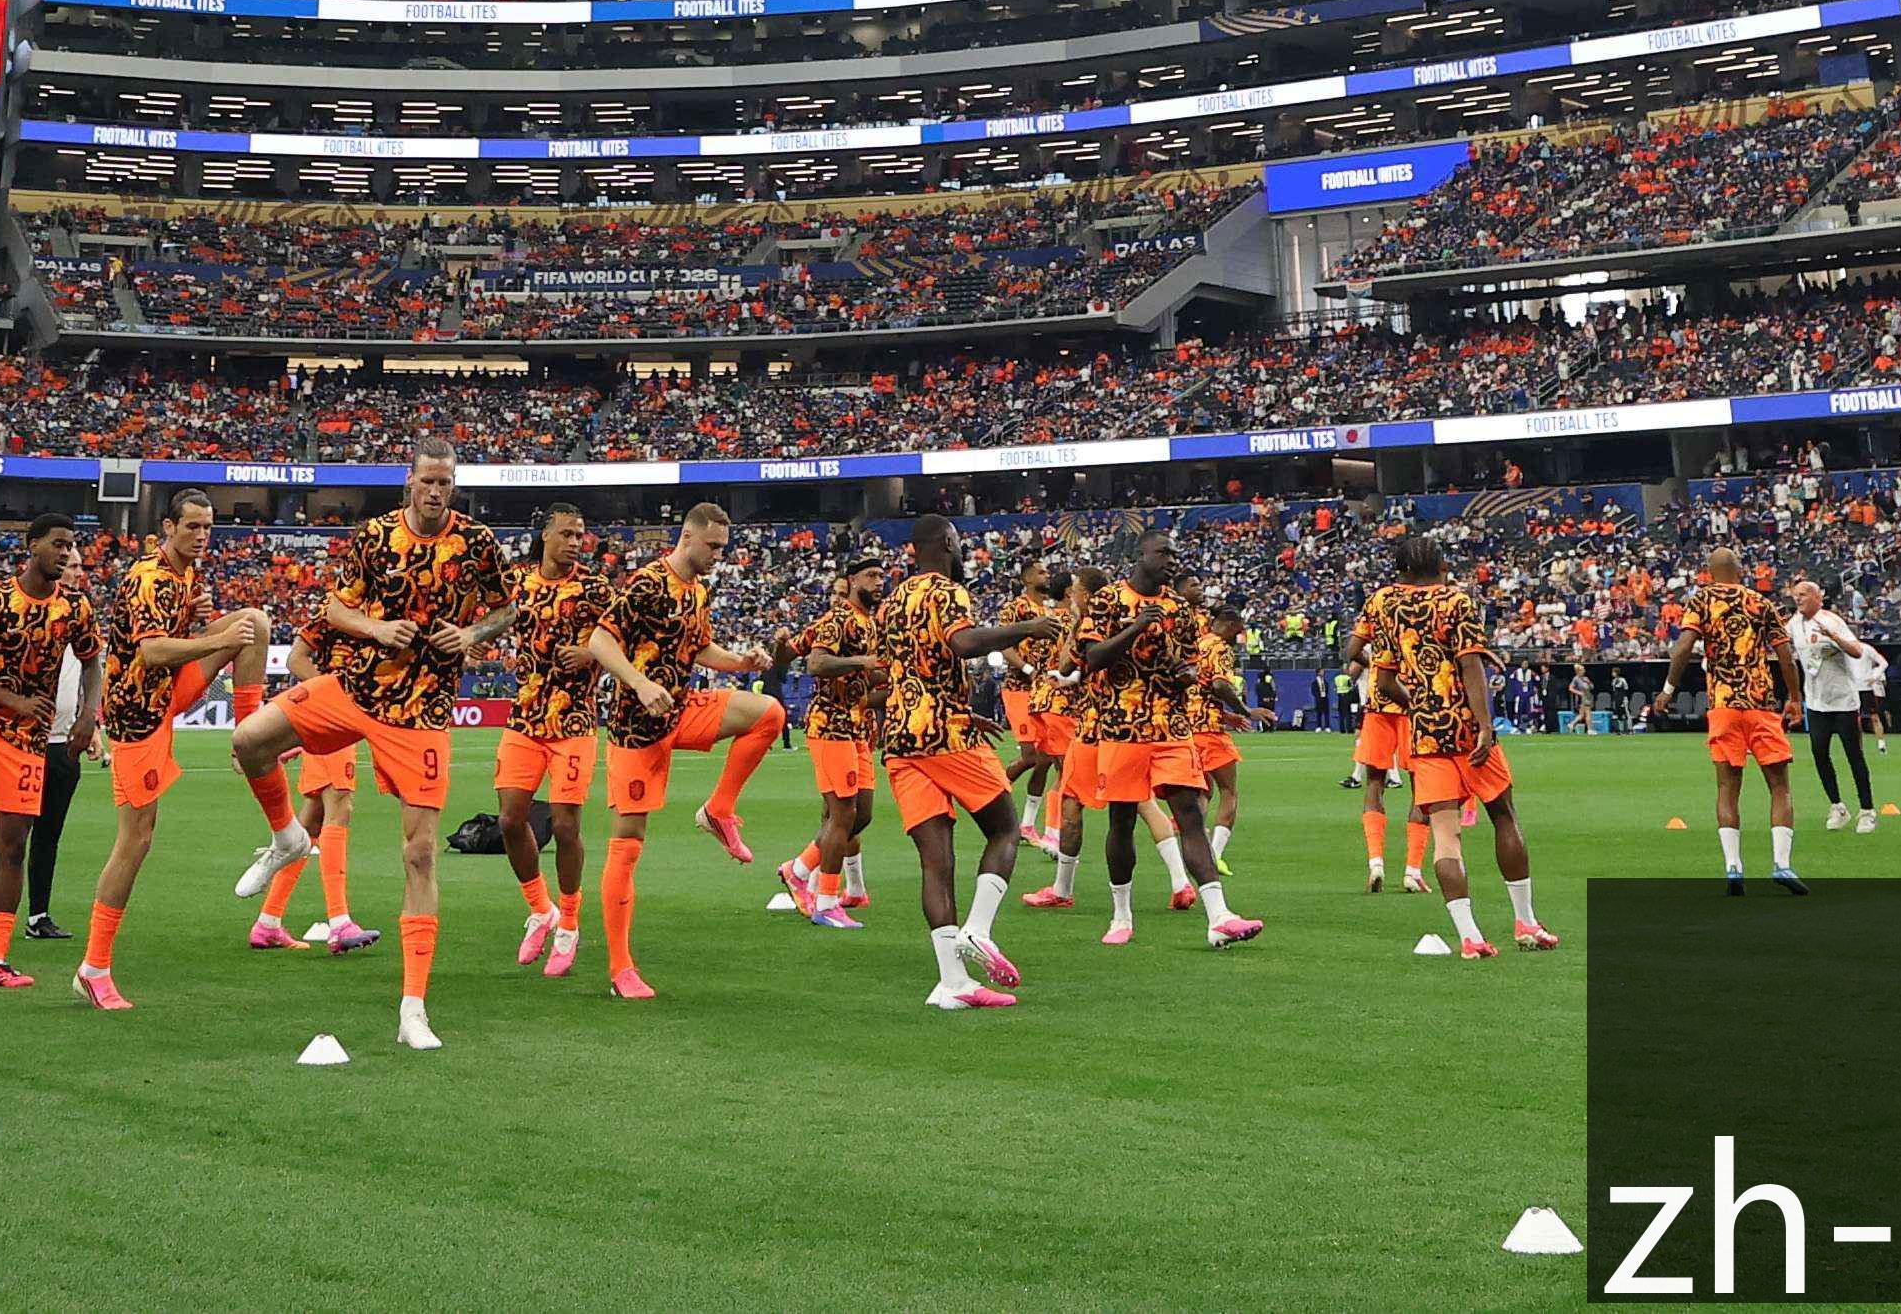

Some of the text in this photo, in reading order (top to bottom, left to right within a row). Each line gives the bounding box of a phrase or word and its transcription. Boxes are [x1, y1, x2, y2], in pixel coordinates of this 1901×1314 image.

[405, 4, 467, 18] FOOTBALL
[674, 0, 736, 16] FOOTBALL
[1647, 29, 1704, 50] FOOTBALL
[1413, 61, 1467, 85] FOOTBALL
[1198, 93, 1246, 112] FOOTBALL
[93, 126, 145, 146] FOOTBALL
[986, 117, 1036, 137] FOOTBALL
[323, 139, 373, 154] FOOTBALL
[548, 140, 600, 157] FOOTBALL
[771, 134, 820, 150] FOOTBALL
[1321, 168, 1377, 190] FOOTBALL
[34, 259, 102, 272] DALLAS
[534, 271, 567, 285] FIFA
[569, 270, 627, 285] WORLD
[1526, 415, 1590, 433] FOOTBALL
[1249, 433, 1311, 452] FOOTBALL
[999, 450, 1054, 466] FOOTBALL
[226, 465, 289, 483] FOOTBALL
[500, 469, 559, 483] FOOTBALL
[760, 461, 818, 479] FOOTBALL
[424, 748, 438, 780] 9
[567, 755, 580, 782] 5
